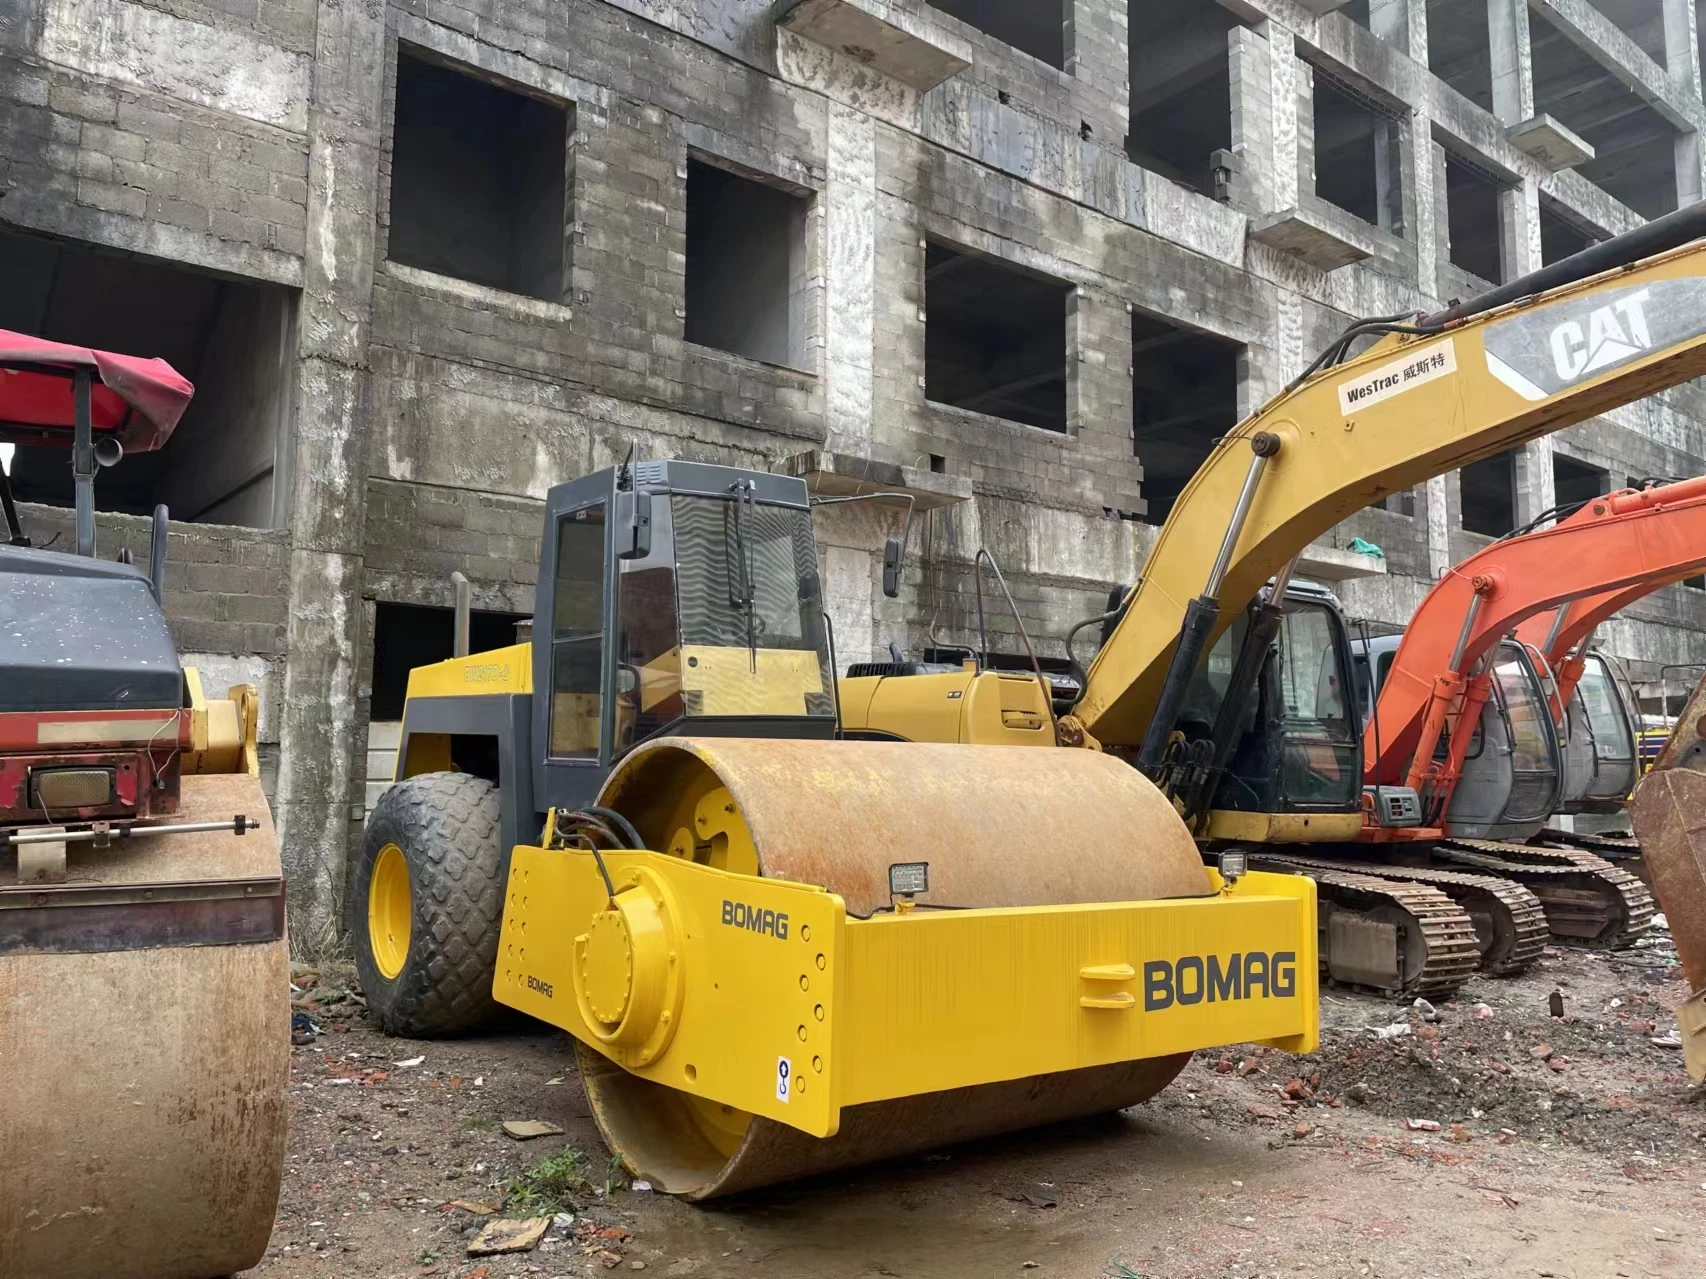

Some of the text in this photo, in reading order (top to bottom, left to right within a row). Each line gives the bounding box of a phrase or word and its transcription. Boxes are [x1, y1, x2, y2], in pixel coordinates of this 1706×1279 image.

[1550, 288, 1652, 380] CAT
[1347, 352, 1445, 403] WesTrac 威斯特
[722, 900, 788, 940] BOMAG
[528, 975, 553, 999] BOMAG
[1144, 952, 1295, 1012] BOMAG
